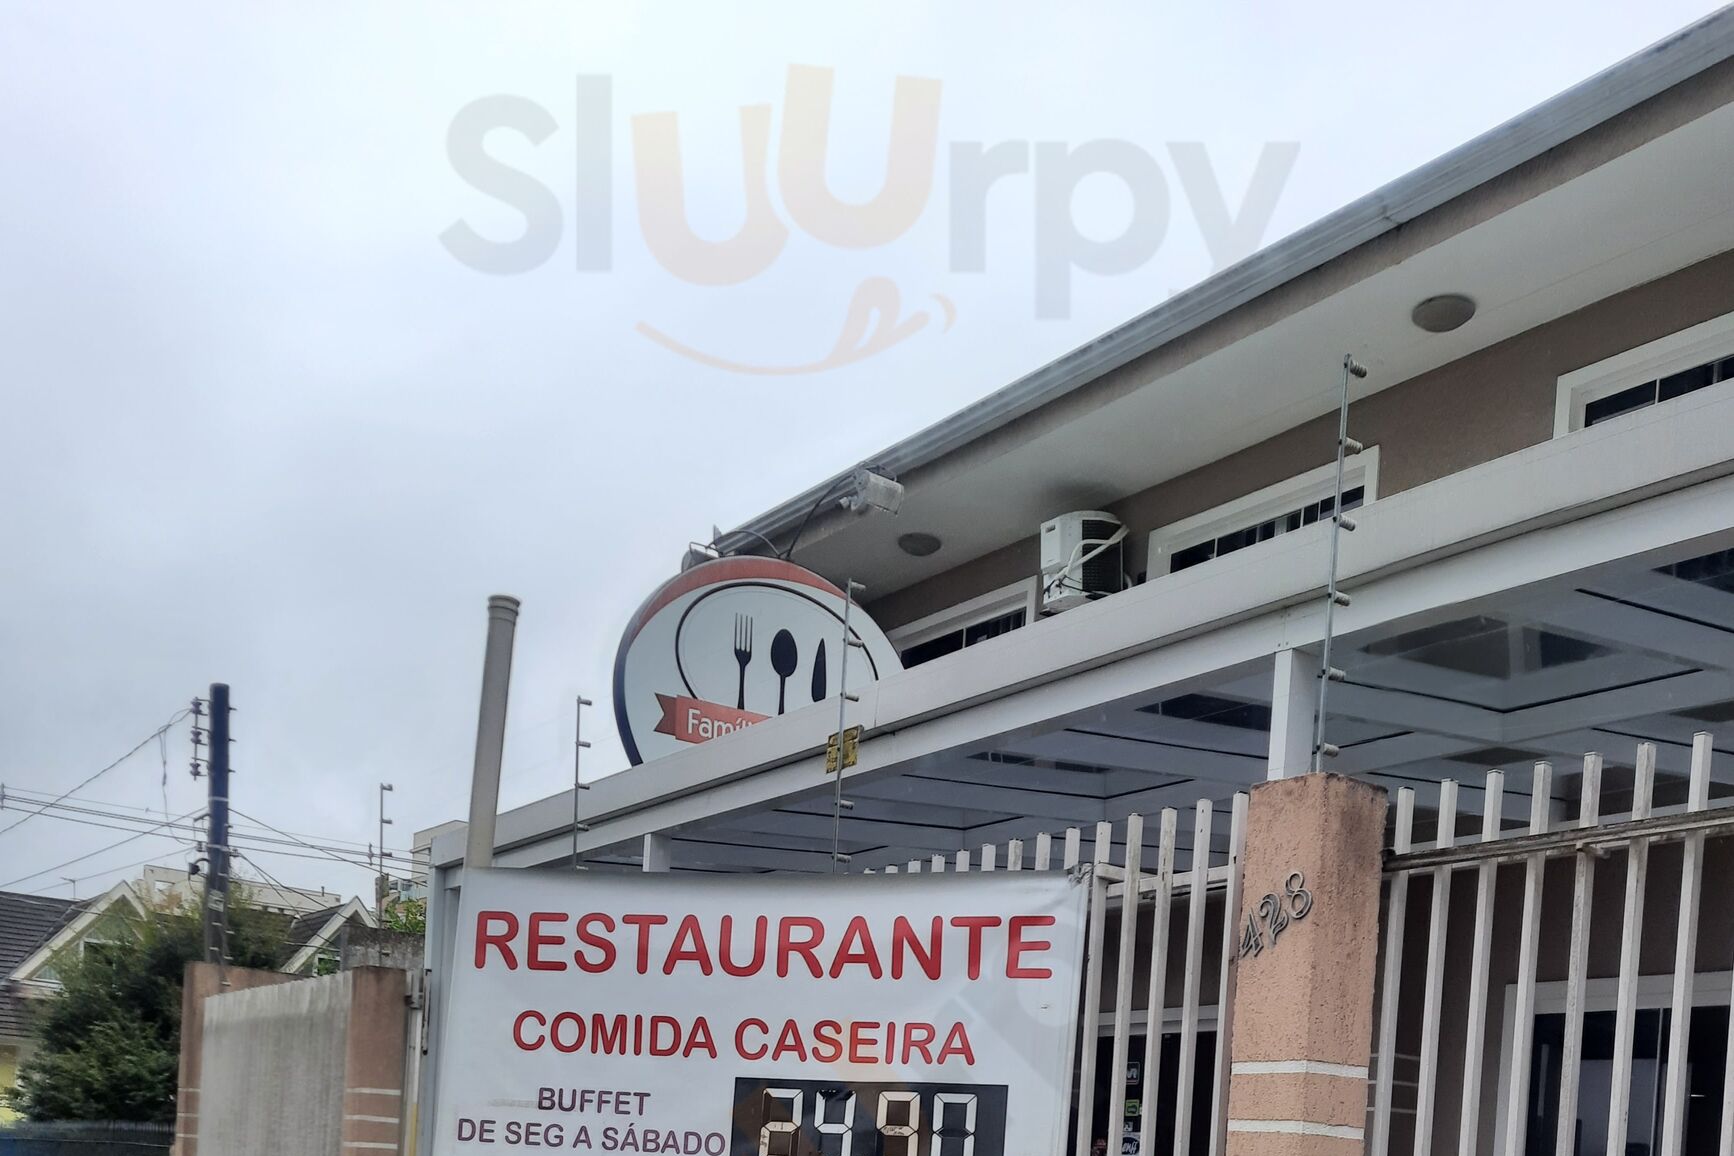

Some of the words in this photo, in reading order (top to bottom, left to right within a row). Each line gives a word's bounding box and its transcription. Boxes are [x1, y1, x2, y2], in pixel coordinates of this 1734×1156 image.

[1241, 871, 1313, 957] 428
[474, 910, 1056, 980] RESTAURANTE
[512, 1009, 717, 1059] COMIDA
[734, 1017, 976, 1065] CASEIRA
[536, 1086, 652, 1116] BUFFET
[457, 1117, 497, 1144] DE
[504, 1120, 564, 1148] SEG
[572, 1125, 593, 1150] A
[601, 1121, 726, 1156] SÁBADO
